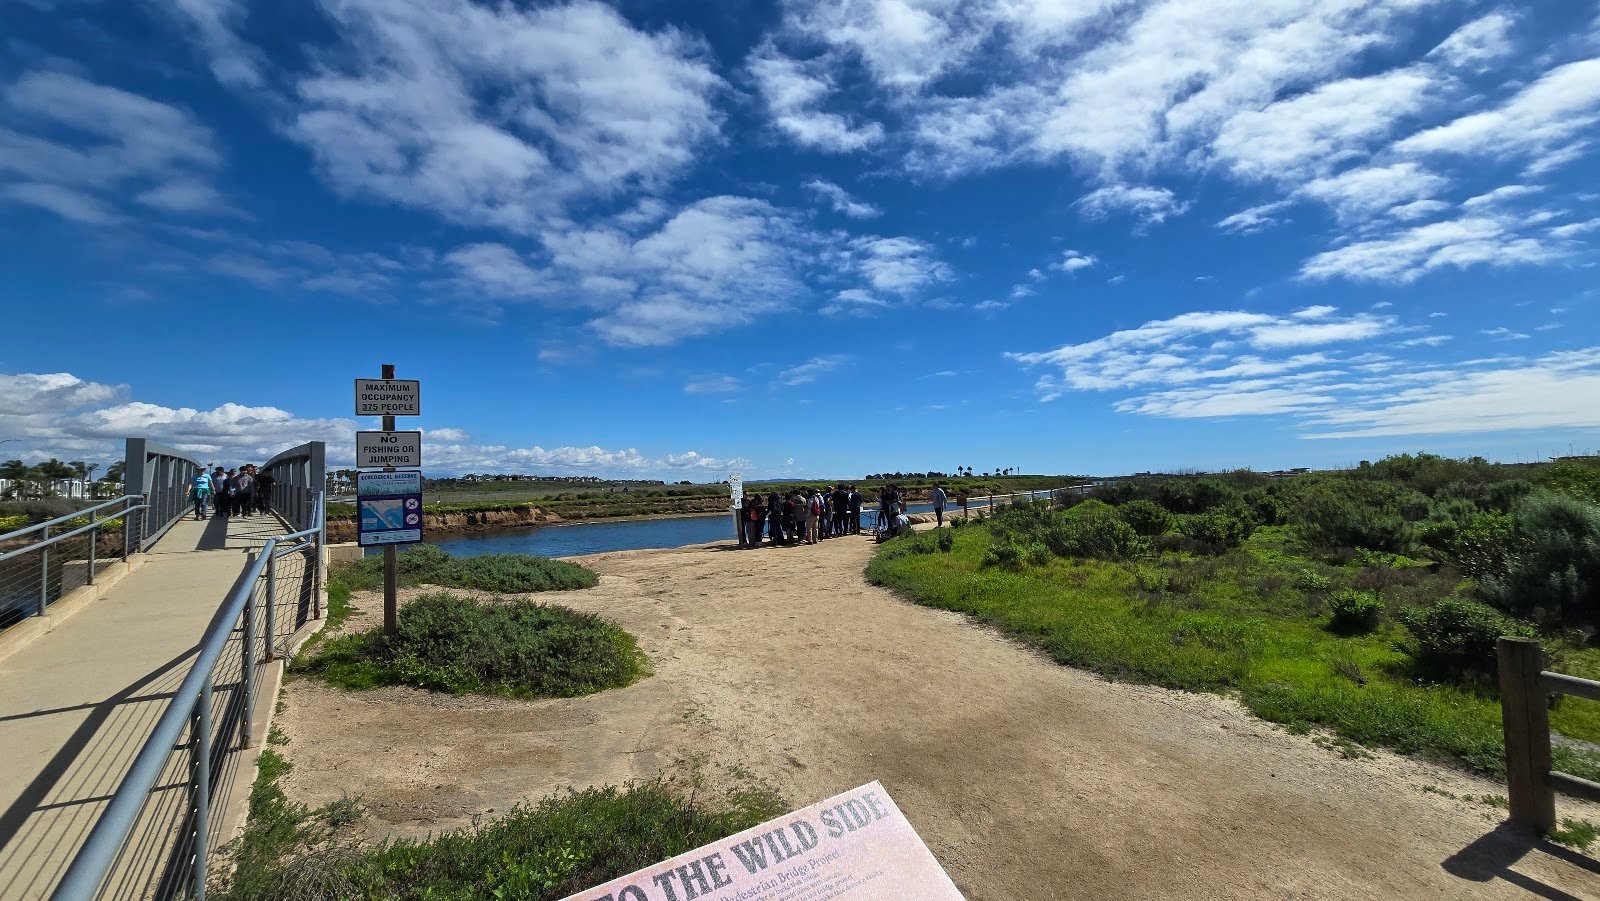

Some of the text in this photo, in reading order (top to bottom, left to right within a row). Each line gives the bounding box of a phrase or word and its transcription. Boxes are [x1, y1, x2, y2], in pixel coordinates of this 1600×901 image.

[365, 384, 410, 392] MAXIMUM
[361, 393, 415, 402] OCCUPANCY
[362, 403, 414, 411] 375 PEOPLE
[402, 445, 415, 453] OR
[368, 455, 410, 463] JUMPING
[652, 792, 889, 901] THE WILD SIDE
[777, 866, 809, 883] Bridge
[808, 849, 841, 869] Project
